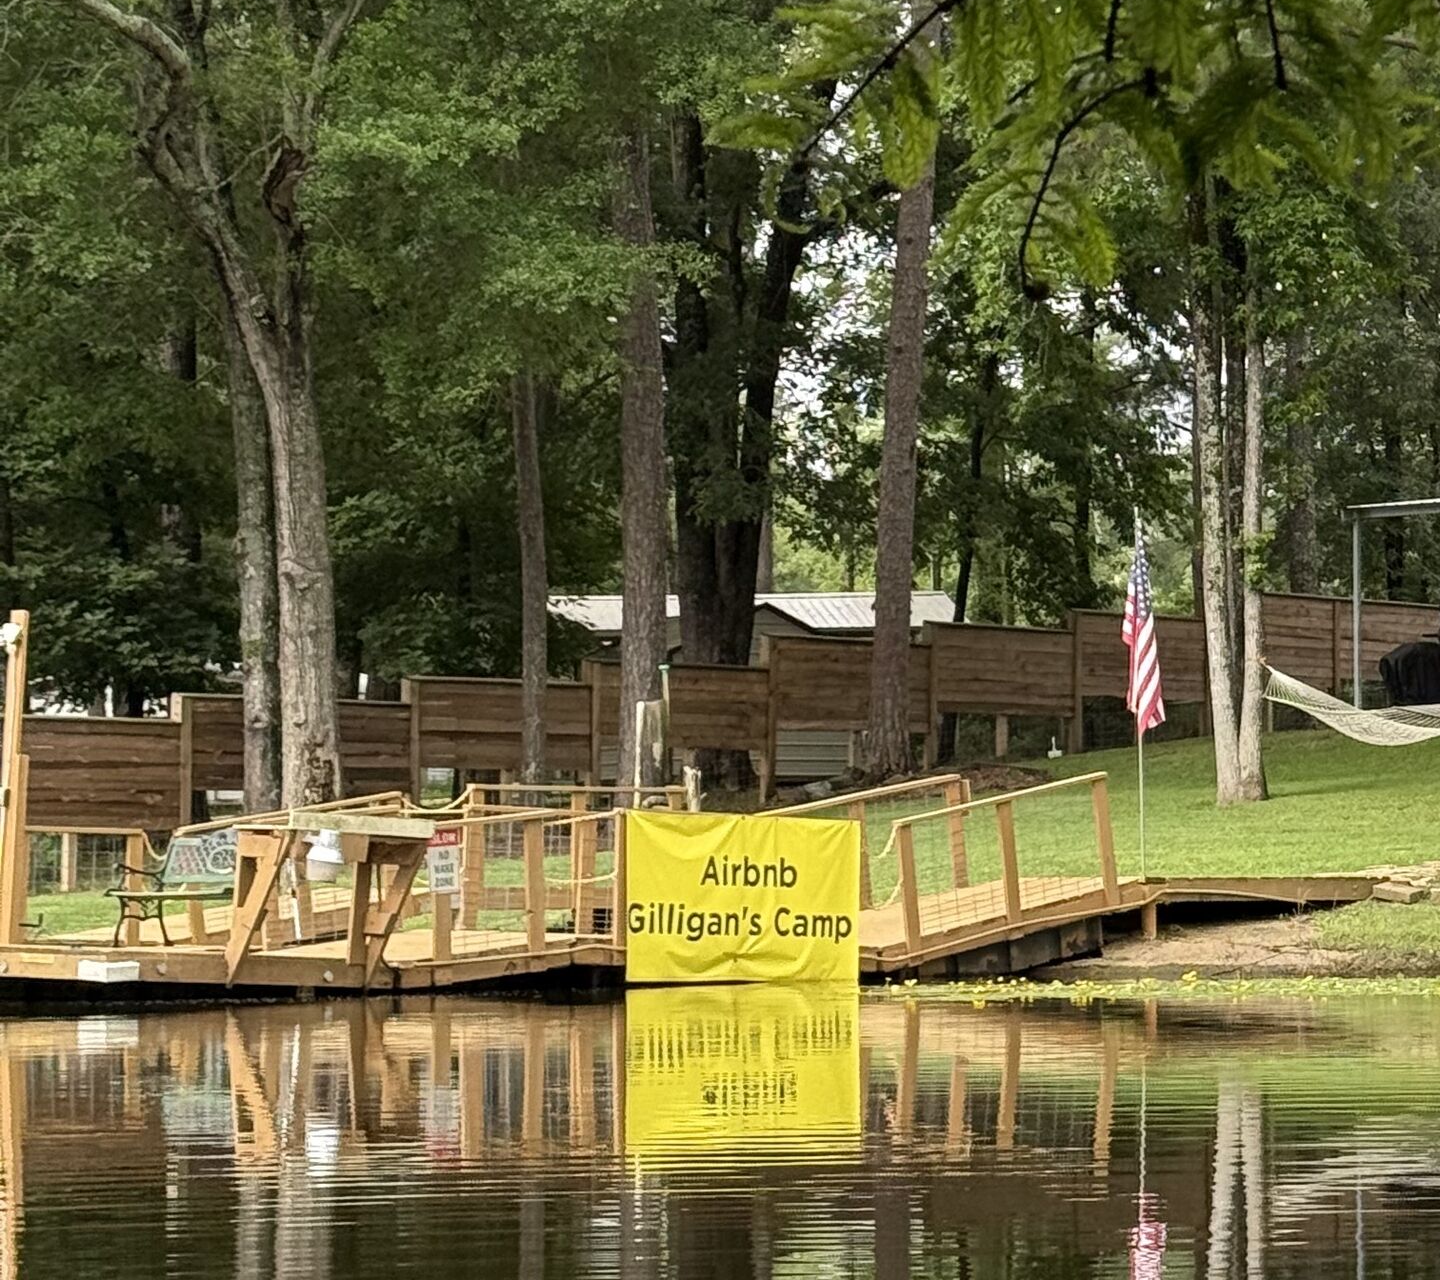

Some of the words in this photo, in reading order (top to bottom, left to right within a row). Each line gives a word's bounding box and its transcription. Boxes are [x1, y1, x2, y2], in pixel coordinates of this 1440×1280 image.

[700, 856, 798, 888] Airbnb
[627, 902, 762, 942] Gilligan's
[774, 907, 853, 944] Camp
